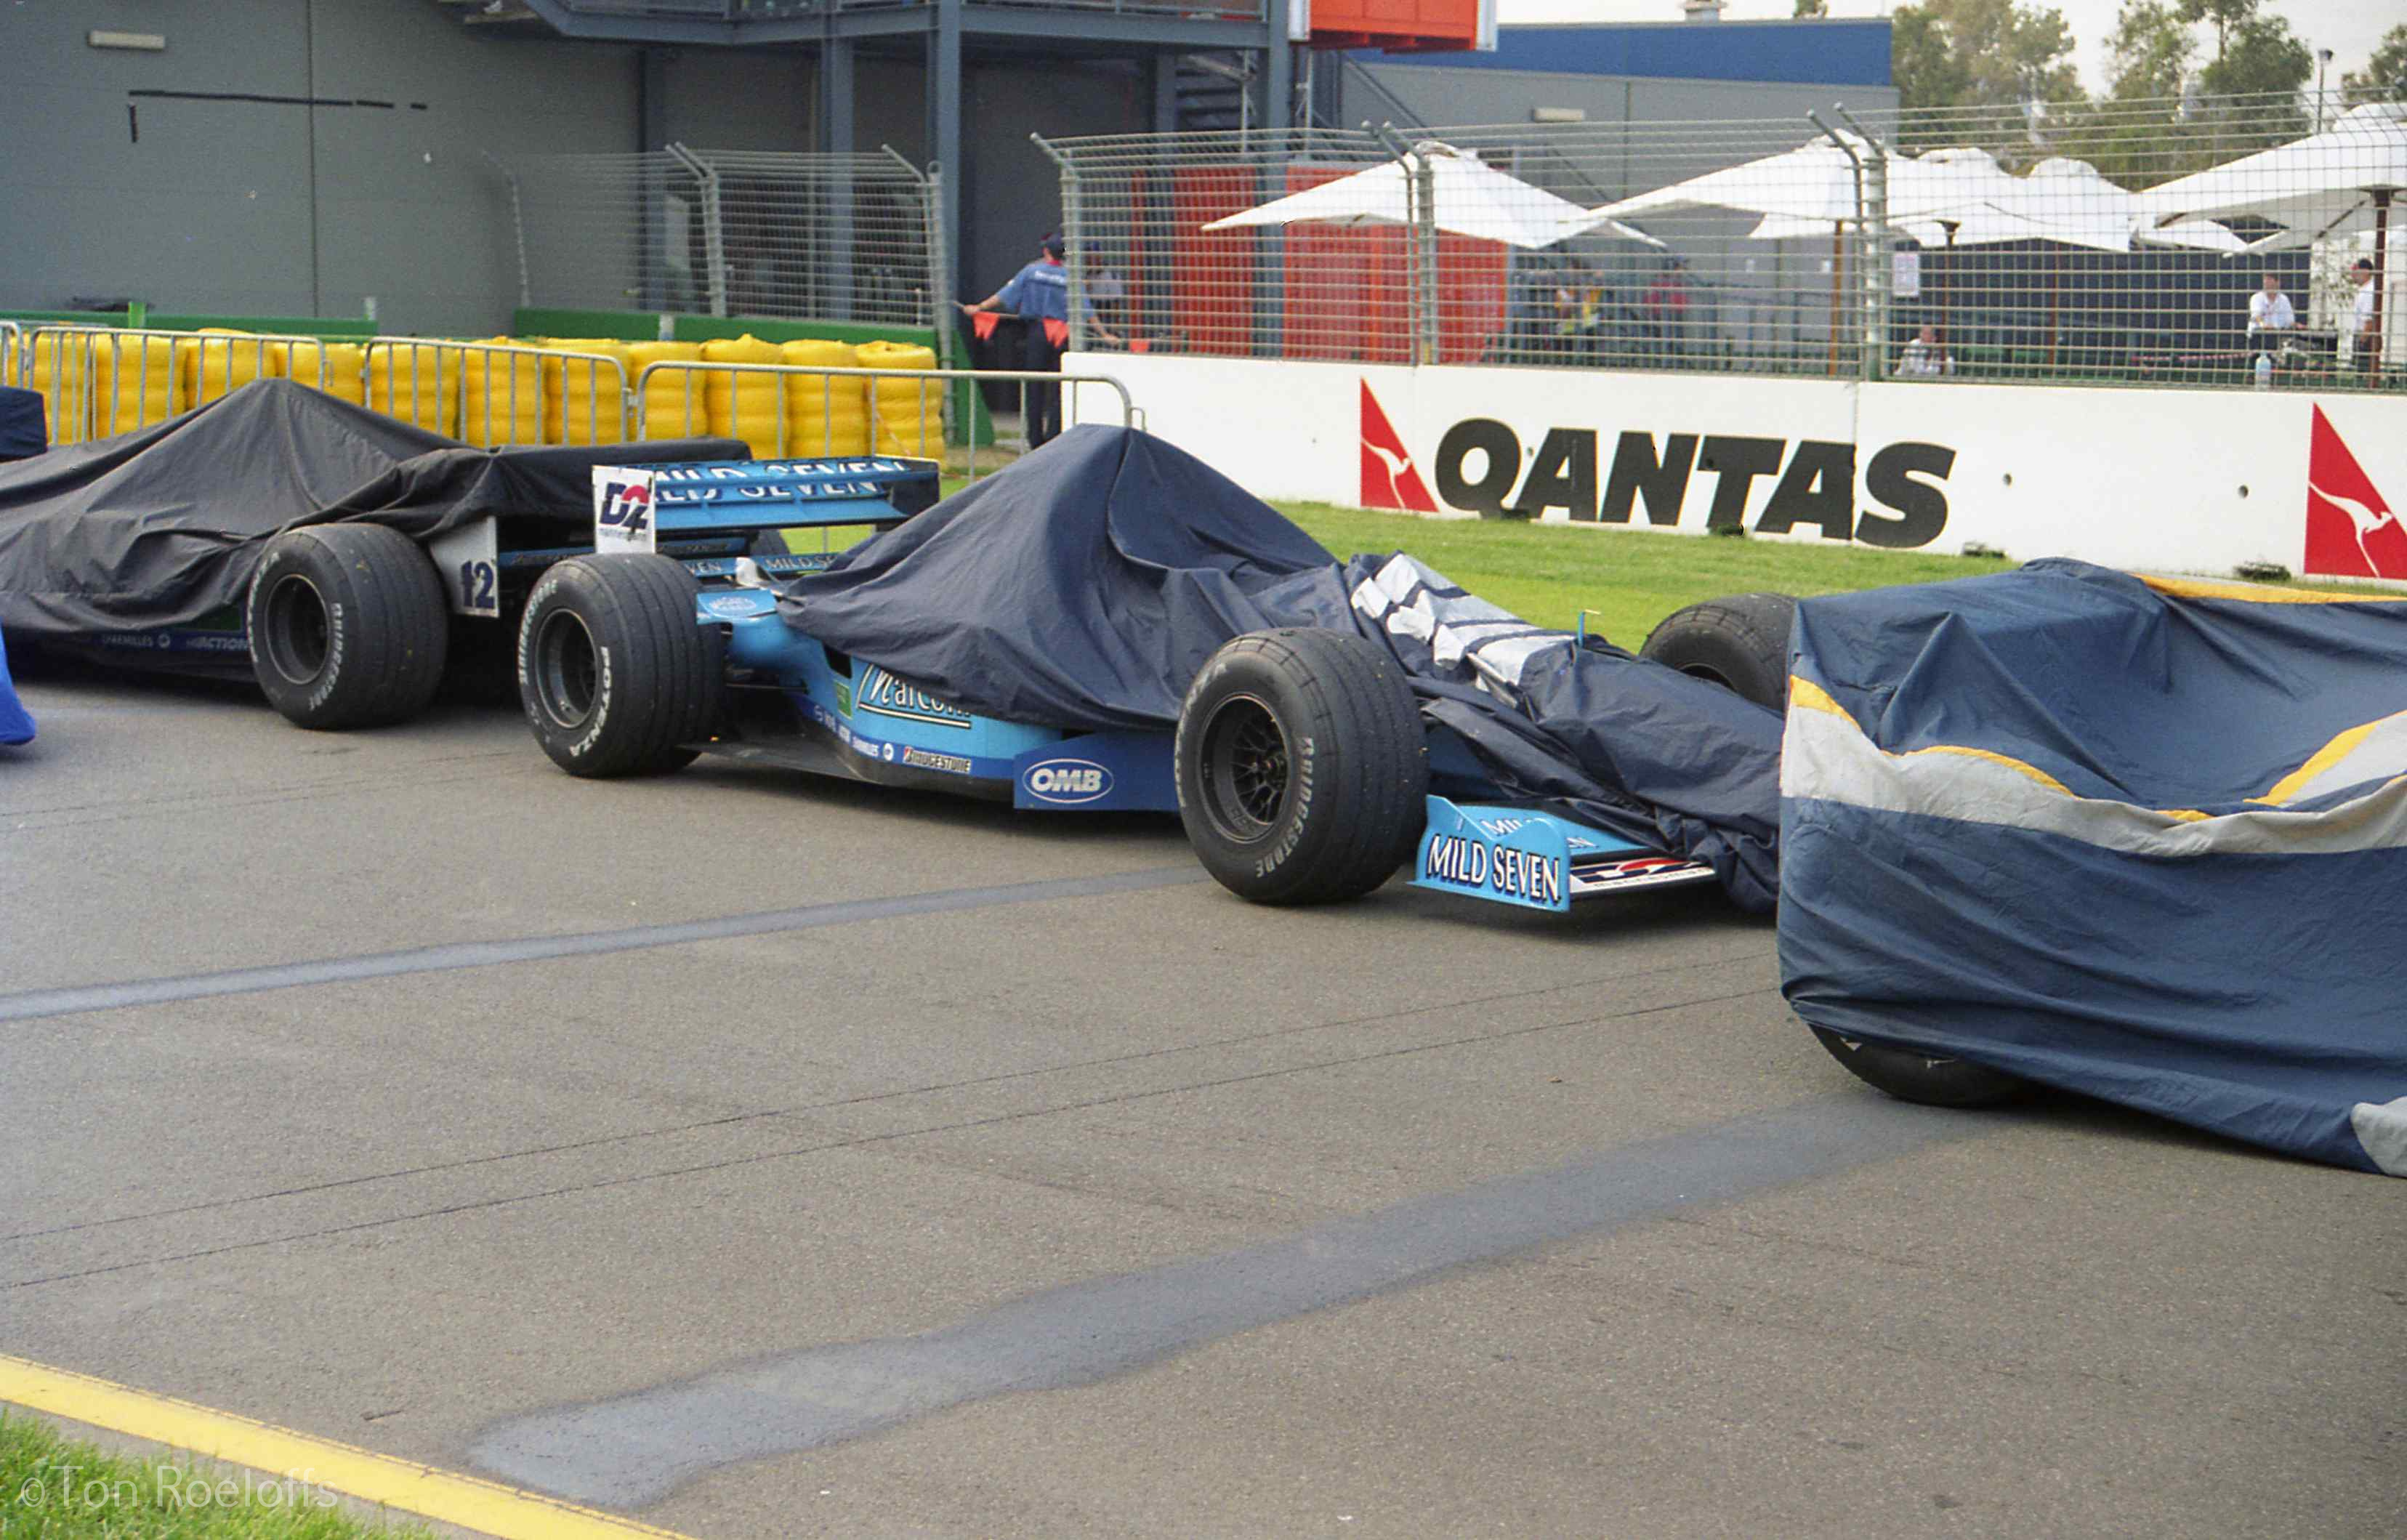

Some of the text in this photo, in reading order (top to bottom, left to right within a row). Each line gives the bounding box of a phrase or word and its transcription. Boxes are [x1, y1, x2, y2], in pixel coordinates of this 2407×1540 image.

[600, 482, 650, 530] D2
[1435, 417, 1956, 549] QANTAS
[461, 560, 496, 609] 12
[765, 557, 813, 570] MILD
[569, 645, 613, 758] POTENZA
[1031, 768, 1102, 791] OMB
[1255, 737, 1315, 878] BRIDGESTONE
[1427, 834, 1561, 903] MILD SEVEN
